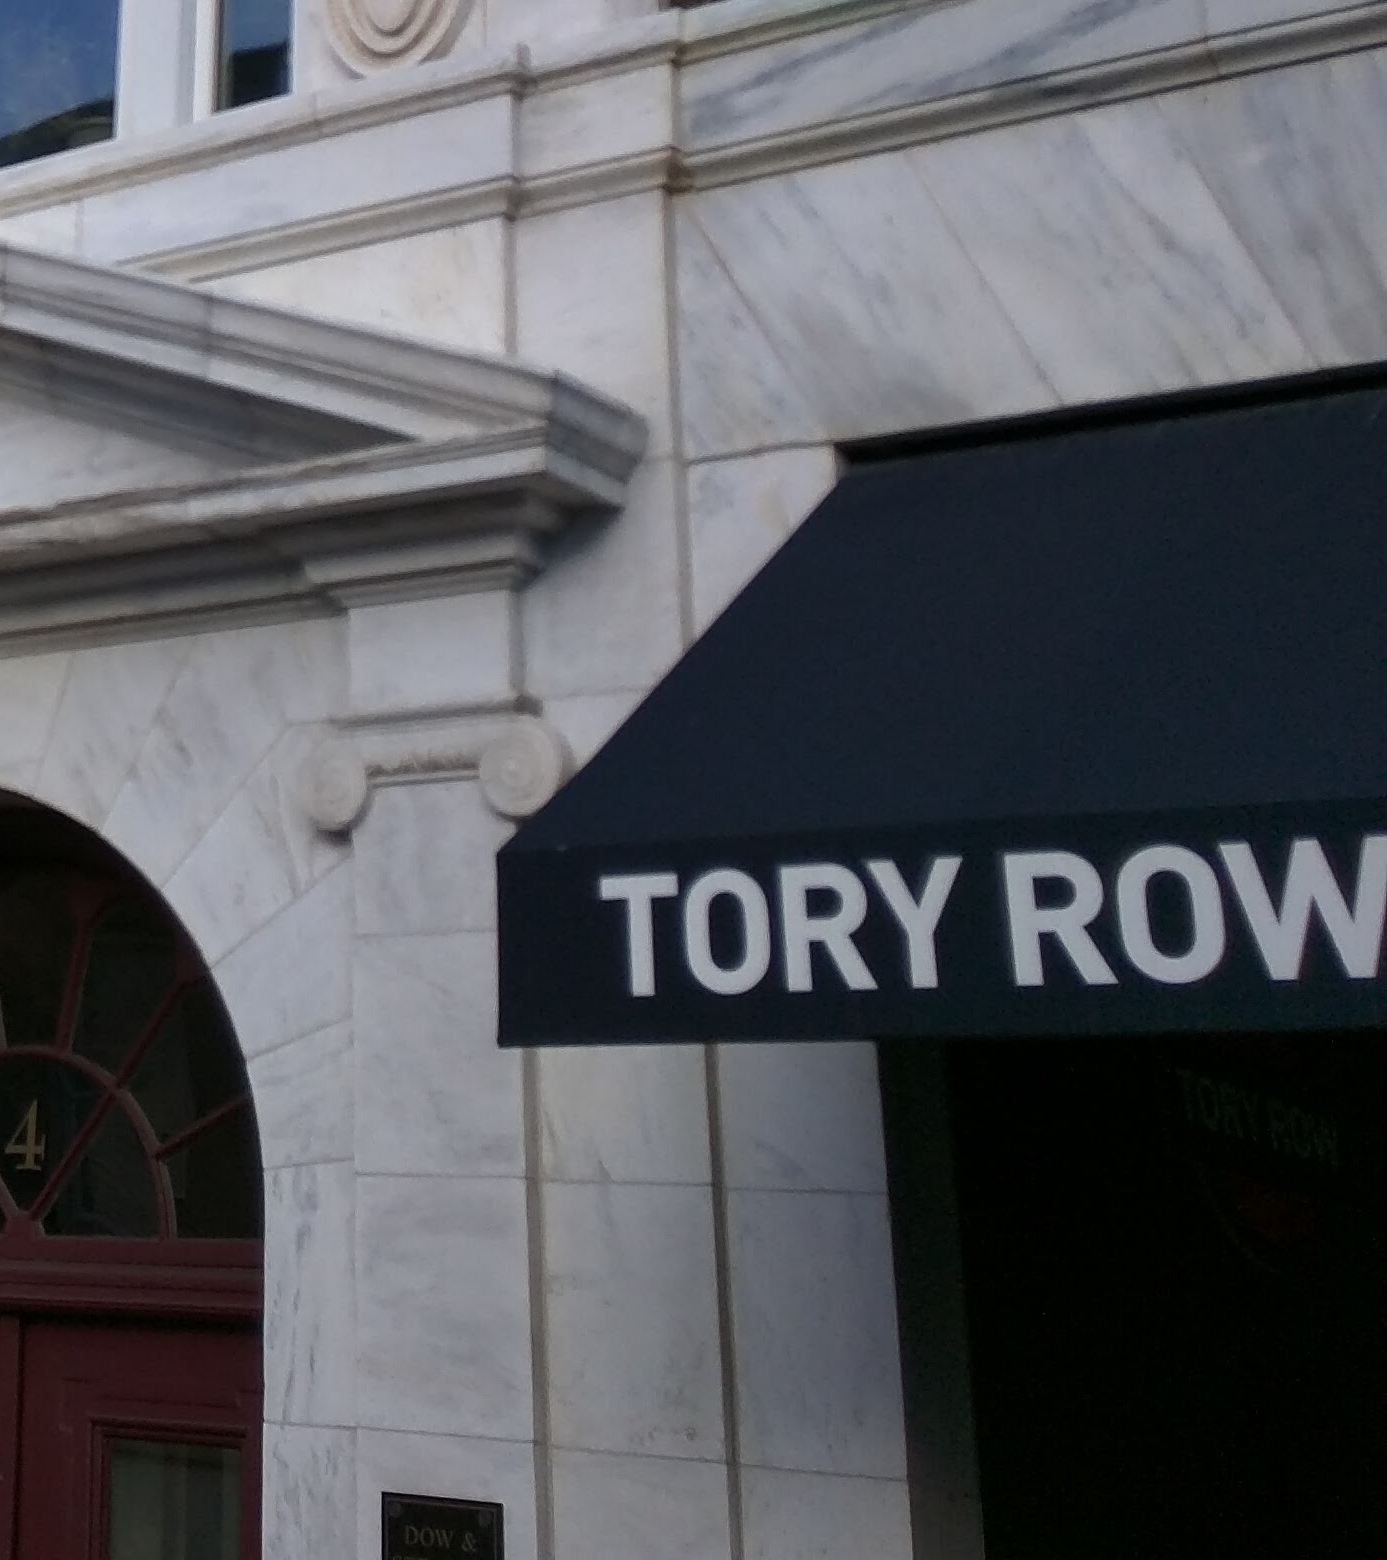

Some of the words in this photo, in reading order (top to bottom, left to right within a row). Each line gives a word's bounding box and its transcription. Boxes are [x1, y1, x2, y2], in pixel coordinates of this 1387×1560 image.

[597, 853, 964, 998] TORY
[1001, 832, 1387, 988] ROW
[4, 1098, 46, 1171] 4
[404, 1524, 454, 1549] DOW
[460, 1531, 477, 1553] &
